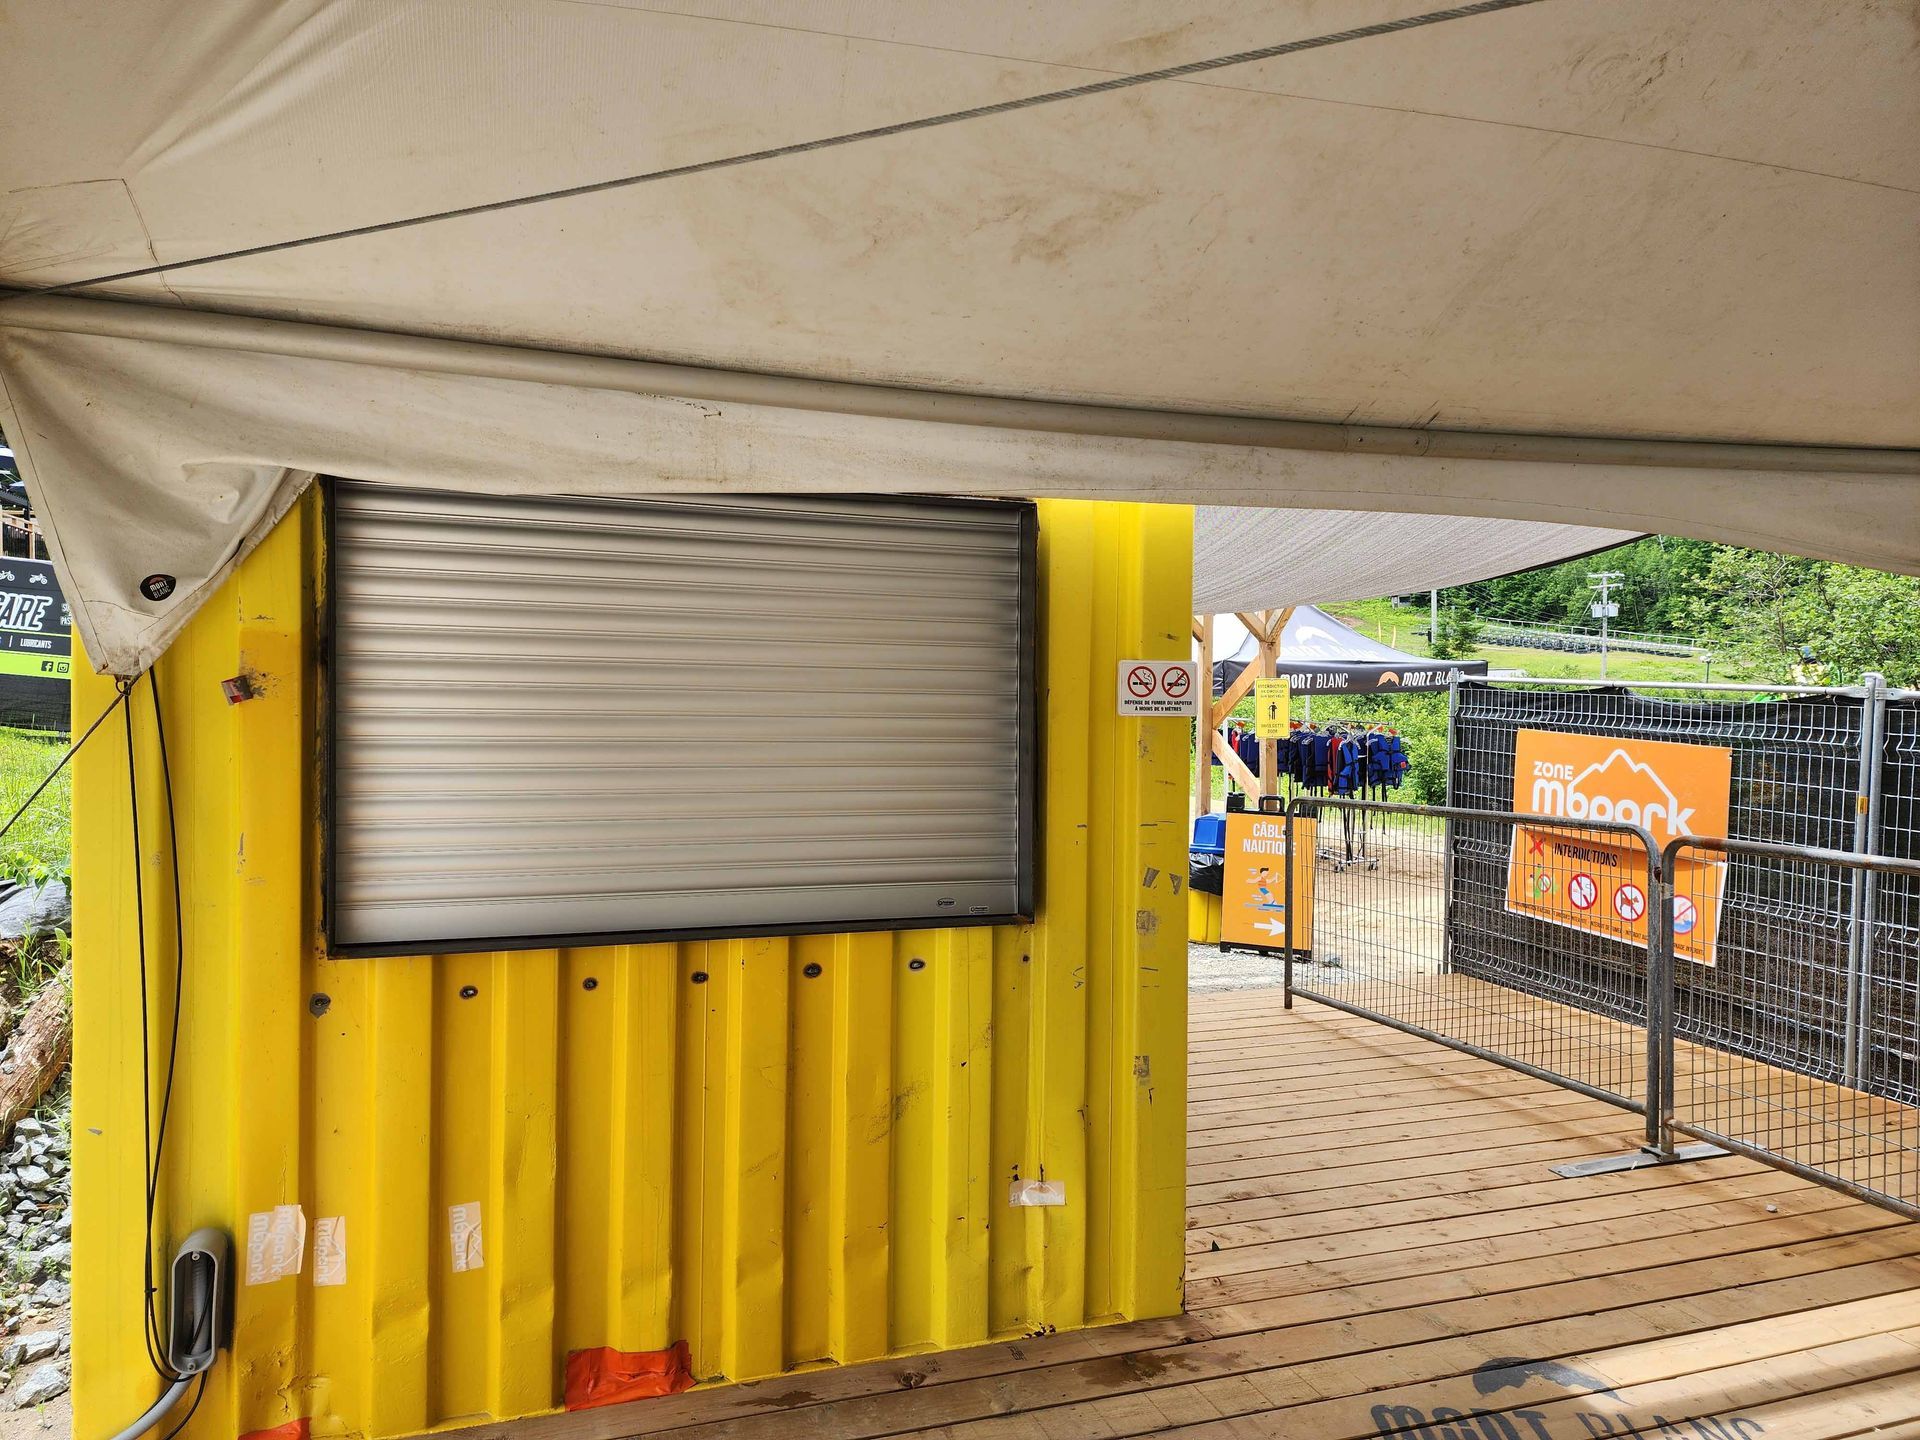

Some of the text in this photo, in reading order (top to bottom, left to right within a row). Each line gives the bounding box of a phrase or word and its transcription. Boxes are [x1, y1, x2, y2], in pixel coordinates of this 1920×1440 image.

[1316, 672, 1349, 689] BLANC
[1533, 761, 1574, 780] ZONE
[1243, 839, 1296, 856] NAUTIQE
[1554, 842, 1618, 867] INTERDICTIONS
